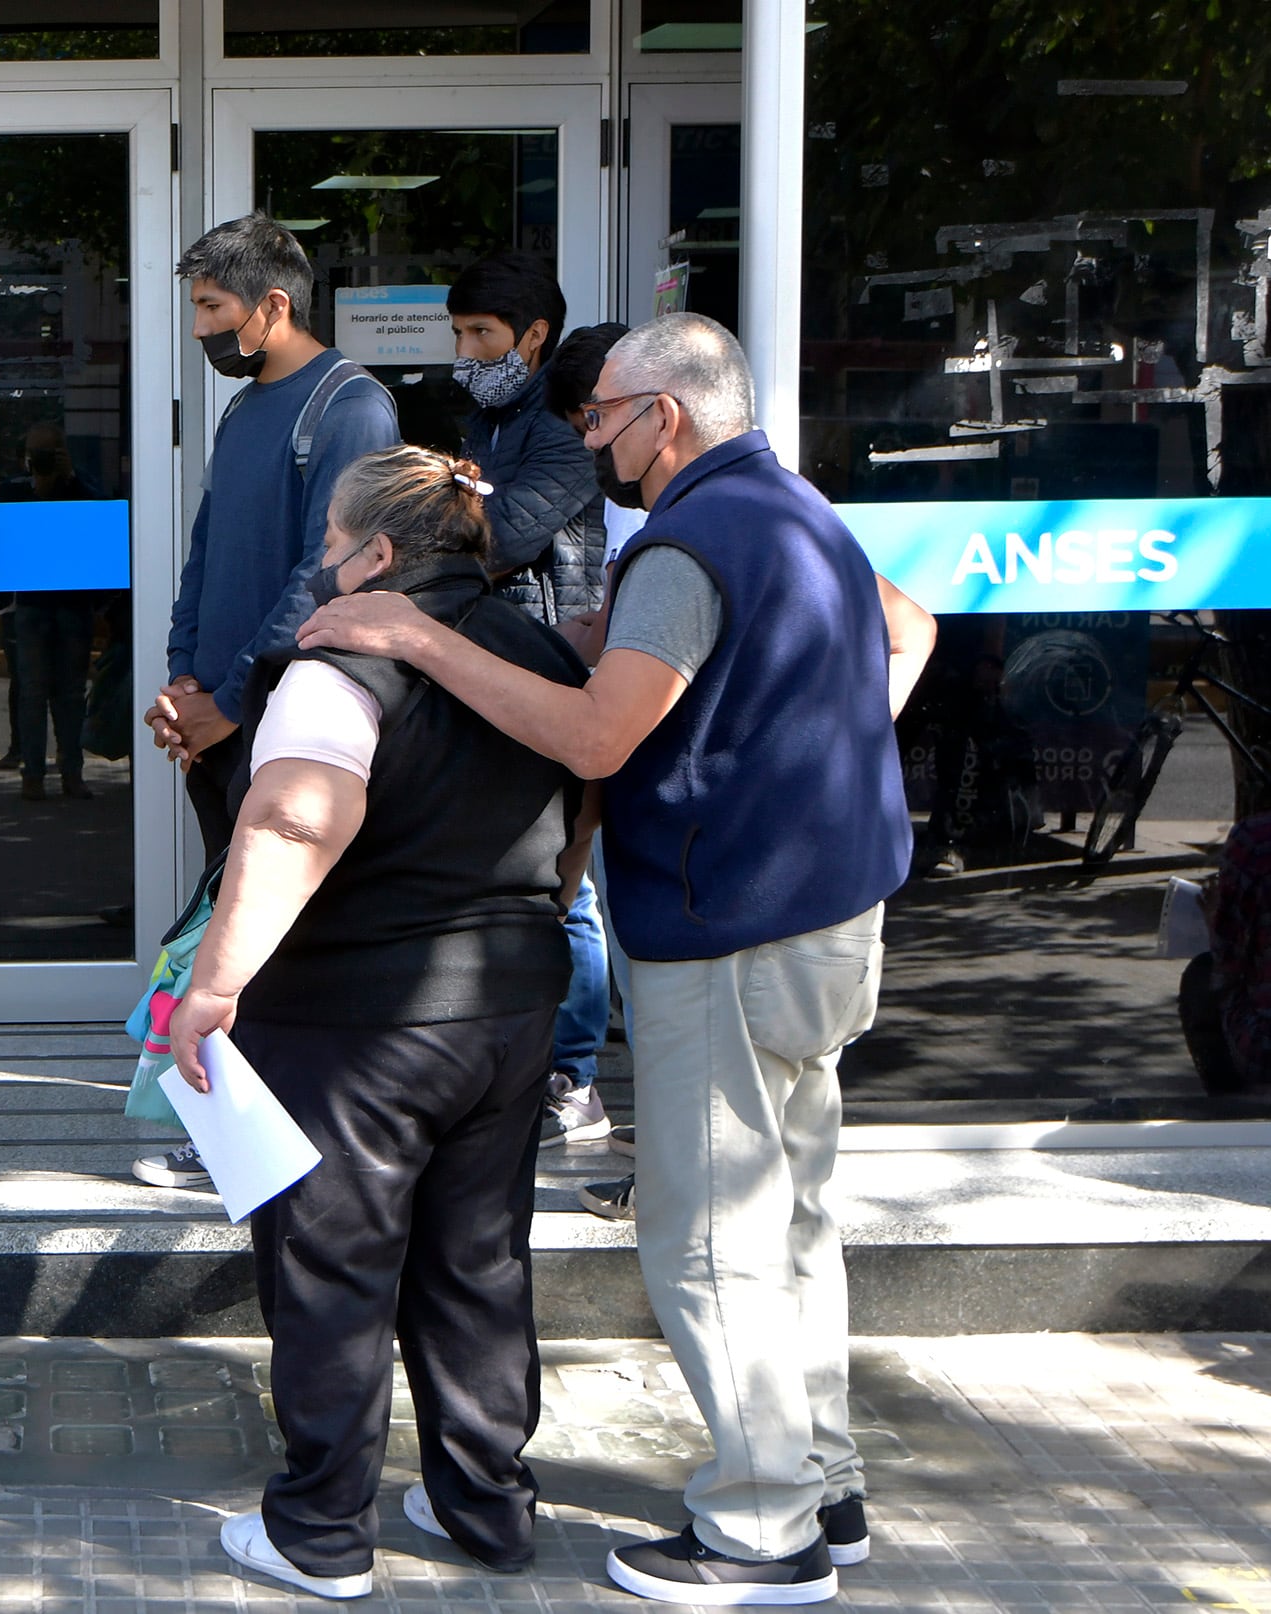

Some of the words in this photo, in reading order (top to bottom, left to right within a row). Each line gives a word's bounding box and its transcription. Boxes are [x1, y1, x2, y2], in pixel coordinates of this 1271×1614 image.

[351, 313, 388, 323] Horario
[391, 313, 404, 322] de
[406, 312, 450, 322] atención
[375, 326, 385, 335] al
[387, 325, 425, 336] público
[395, 345, 406, 354] 14
[950, 528, 1181, 585] ANSES
